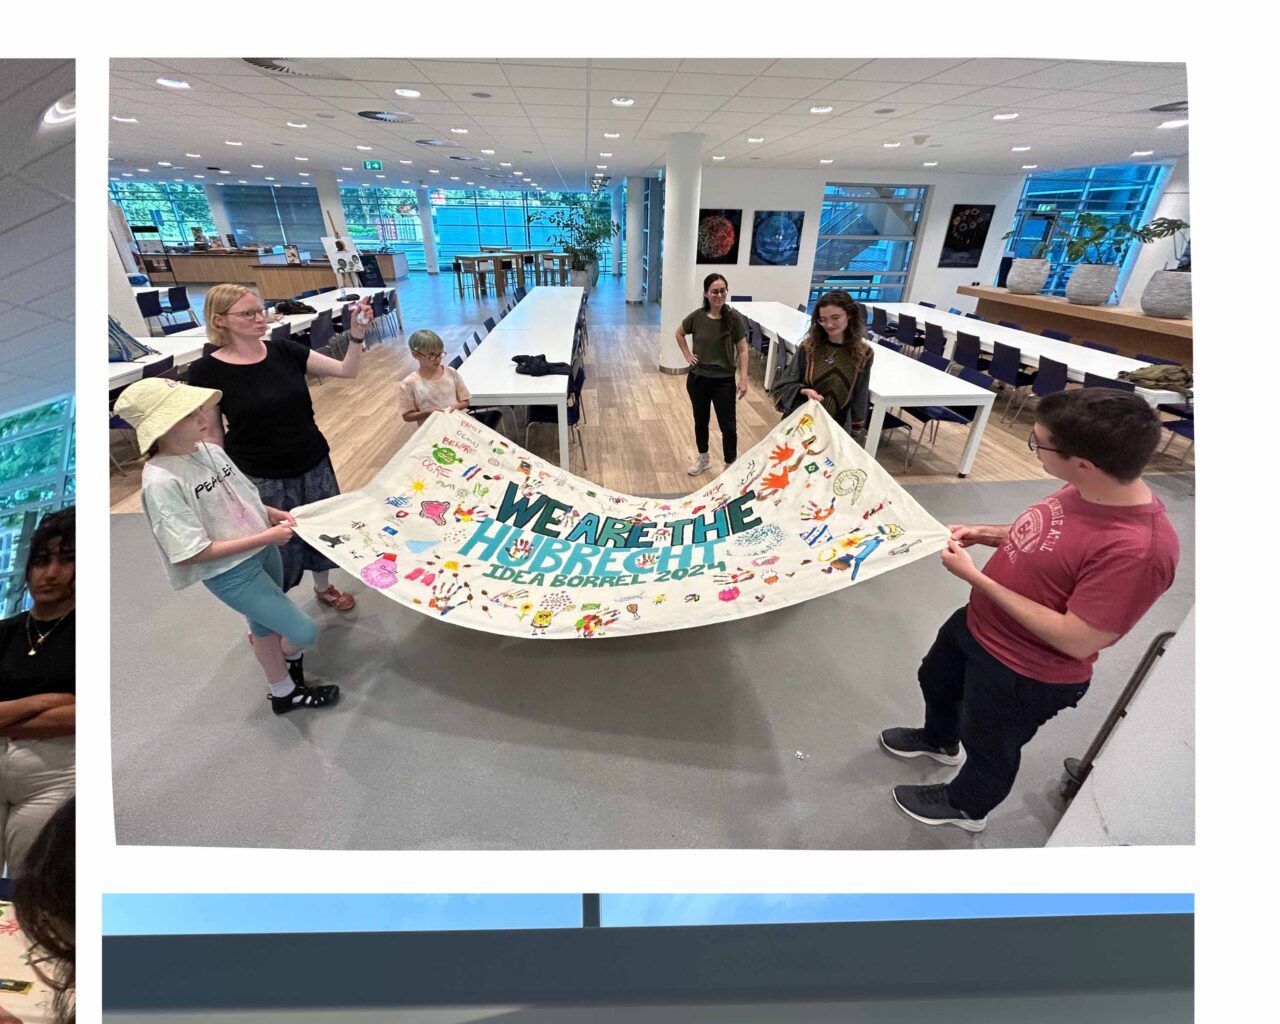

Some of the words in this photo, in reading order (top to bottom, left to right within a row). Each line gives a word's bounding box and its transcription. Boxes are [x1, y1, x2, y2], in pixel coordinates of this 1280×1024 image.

[422, 455, 454, 479] OGRE
[496, 481, 569, 538] WE
[566, 512, 657, 549] ARE
[668, 490, 763, 546] THE
[456, 516, 727, 578] HUBRECHT
[482, 562, 546, 586] IDEA
[549, 572, 649, 588] BORREL
[653, 560, 727, 583] 2024
